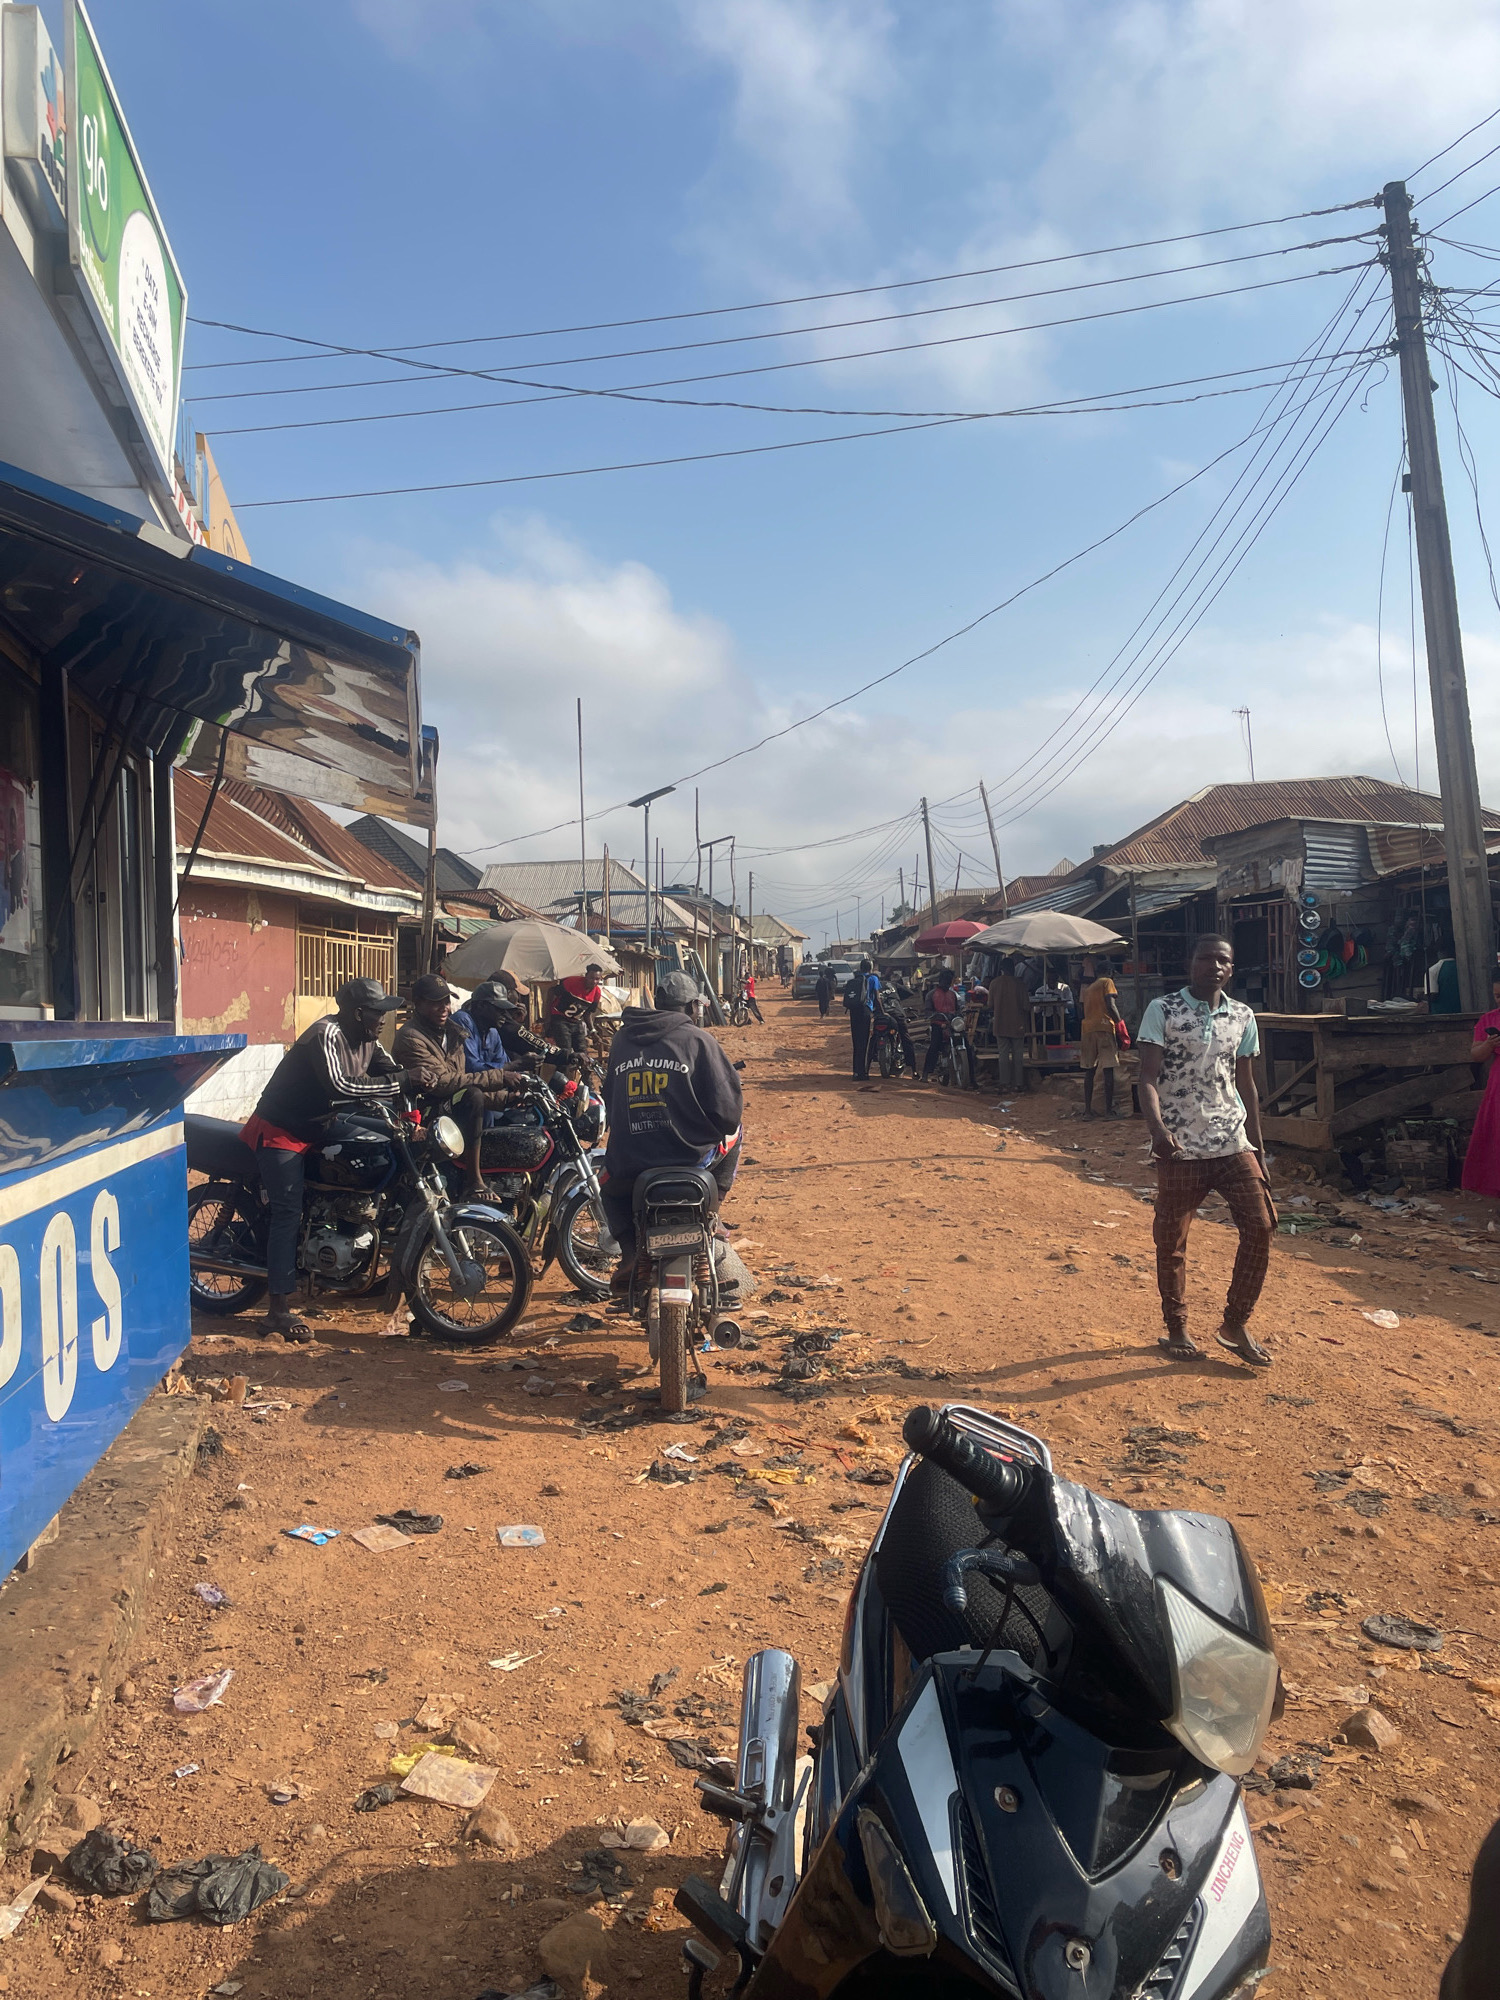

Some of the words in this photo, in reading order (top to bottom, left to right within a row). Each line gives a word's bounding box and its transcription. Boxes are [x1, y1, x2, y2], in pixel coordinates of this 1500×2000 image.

[83, 114, 107, 211] glo
[145, 264, 158, 307] DATA
[615, 1056, 643, 1076] TEAM
[646, 1059, 689, 1074] JUMBO
[1210, 1831, 1245, 1903] JINCHENG
